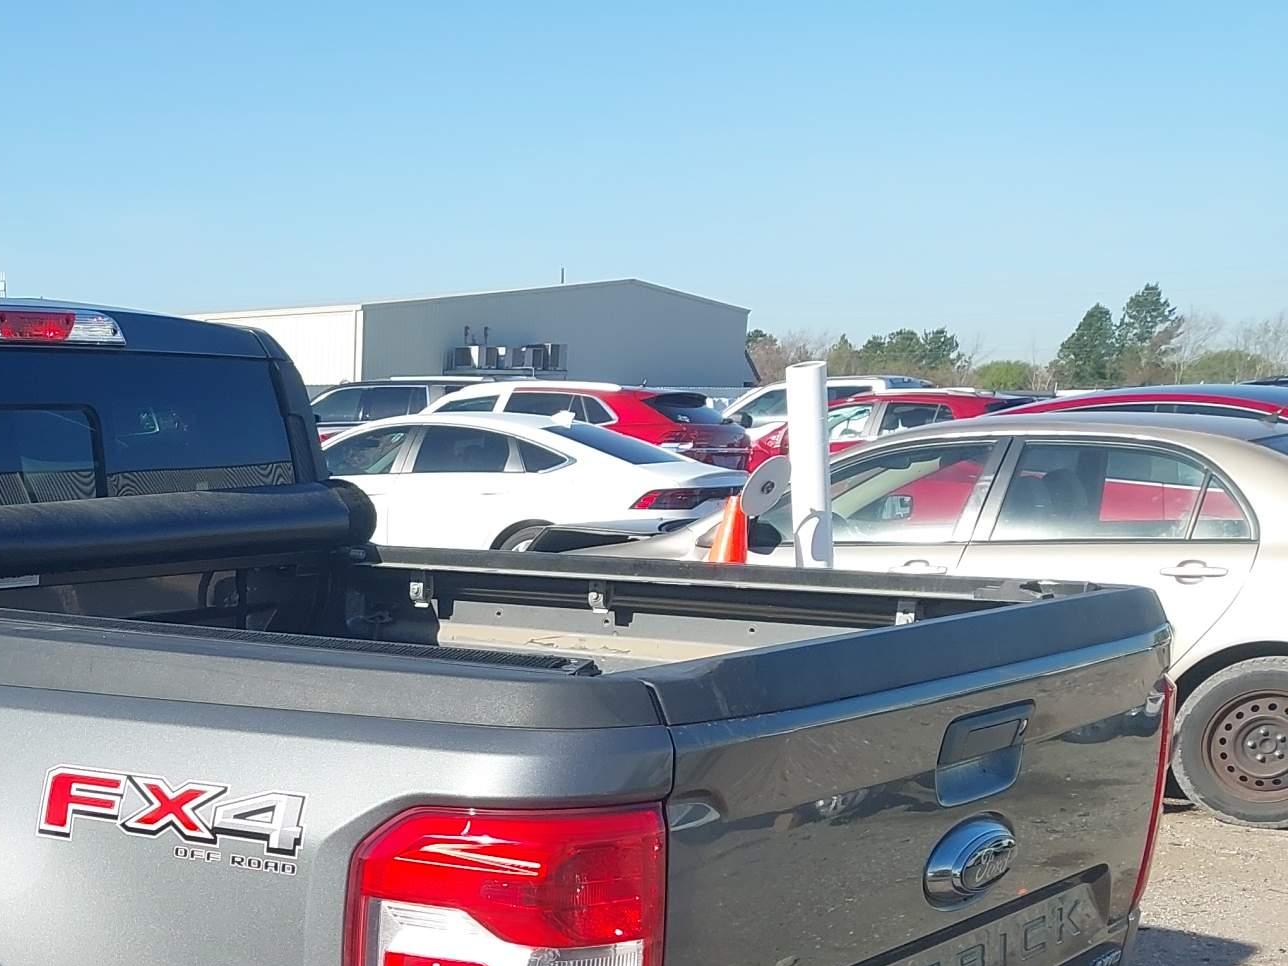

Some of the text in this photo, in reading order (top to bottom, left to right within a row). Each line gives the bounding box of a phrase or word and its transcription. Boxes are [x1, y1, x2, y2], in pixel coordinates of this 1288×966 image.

[36, 764, 310, 857] FX4
[174, 846, 297, 876] OFF ROAD
